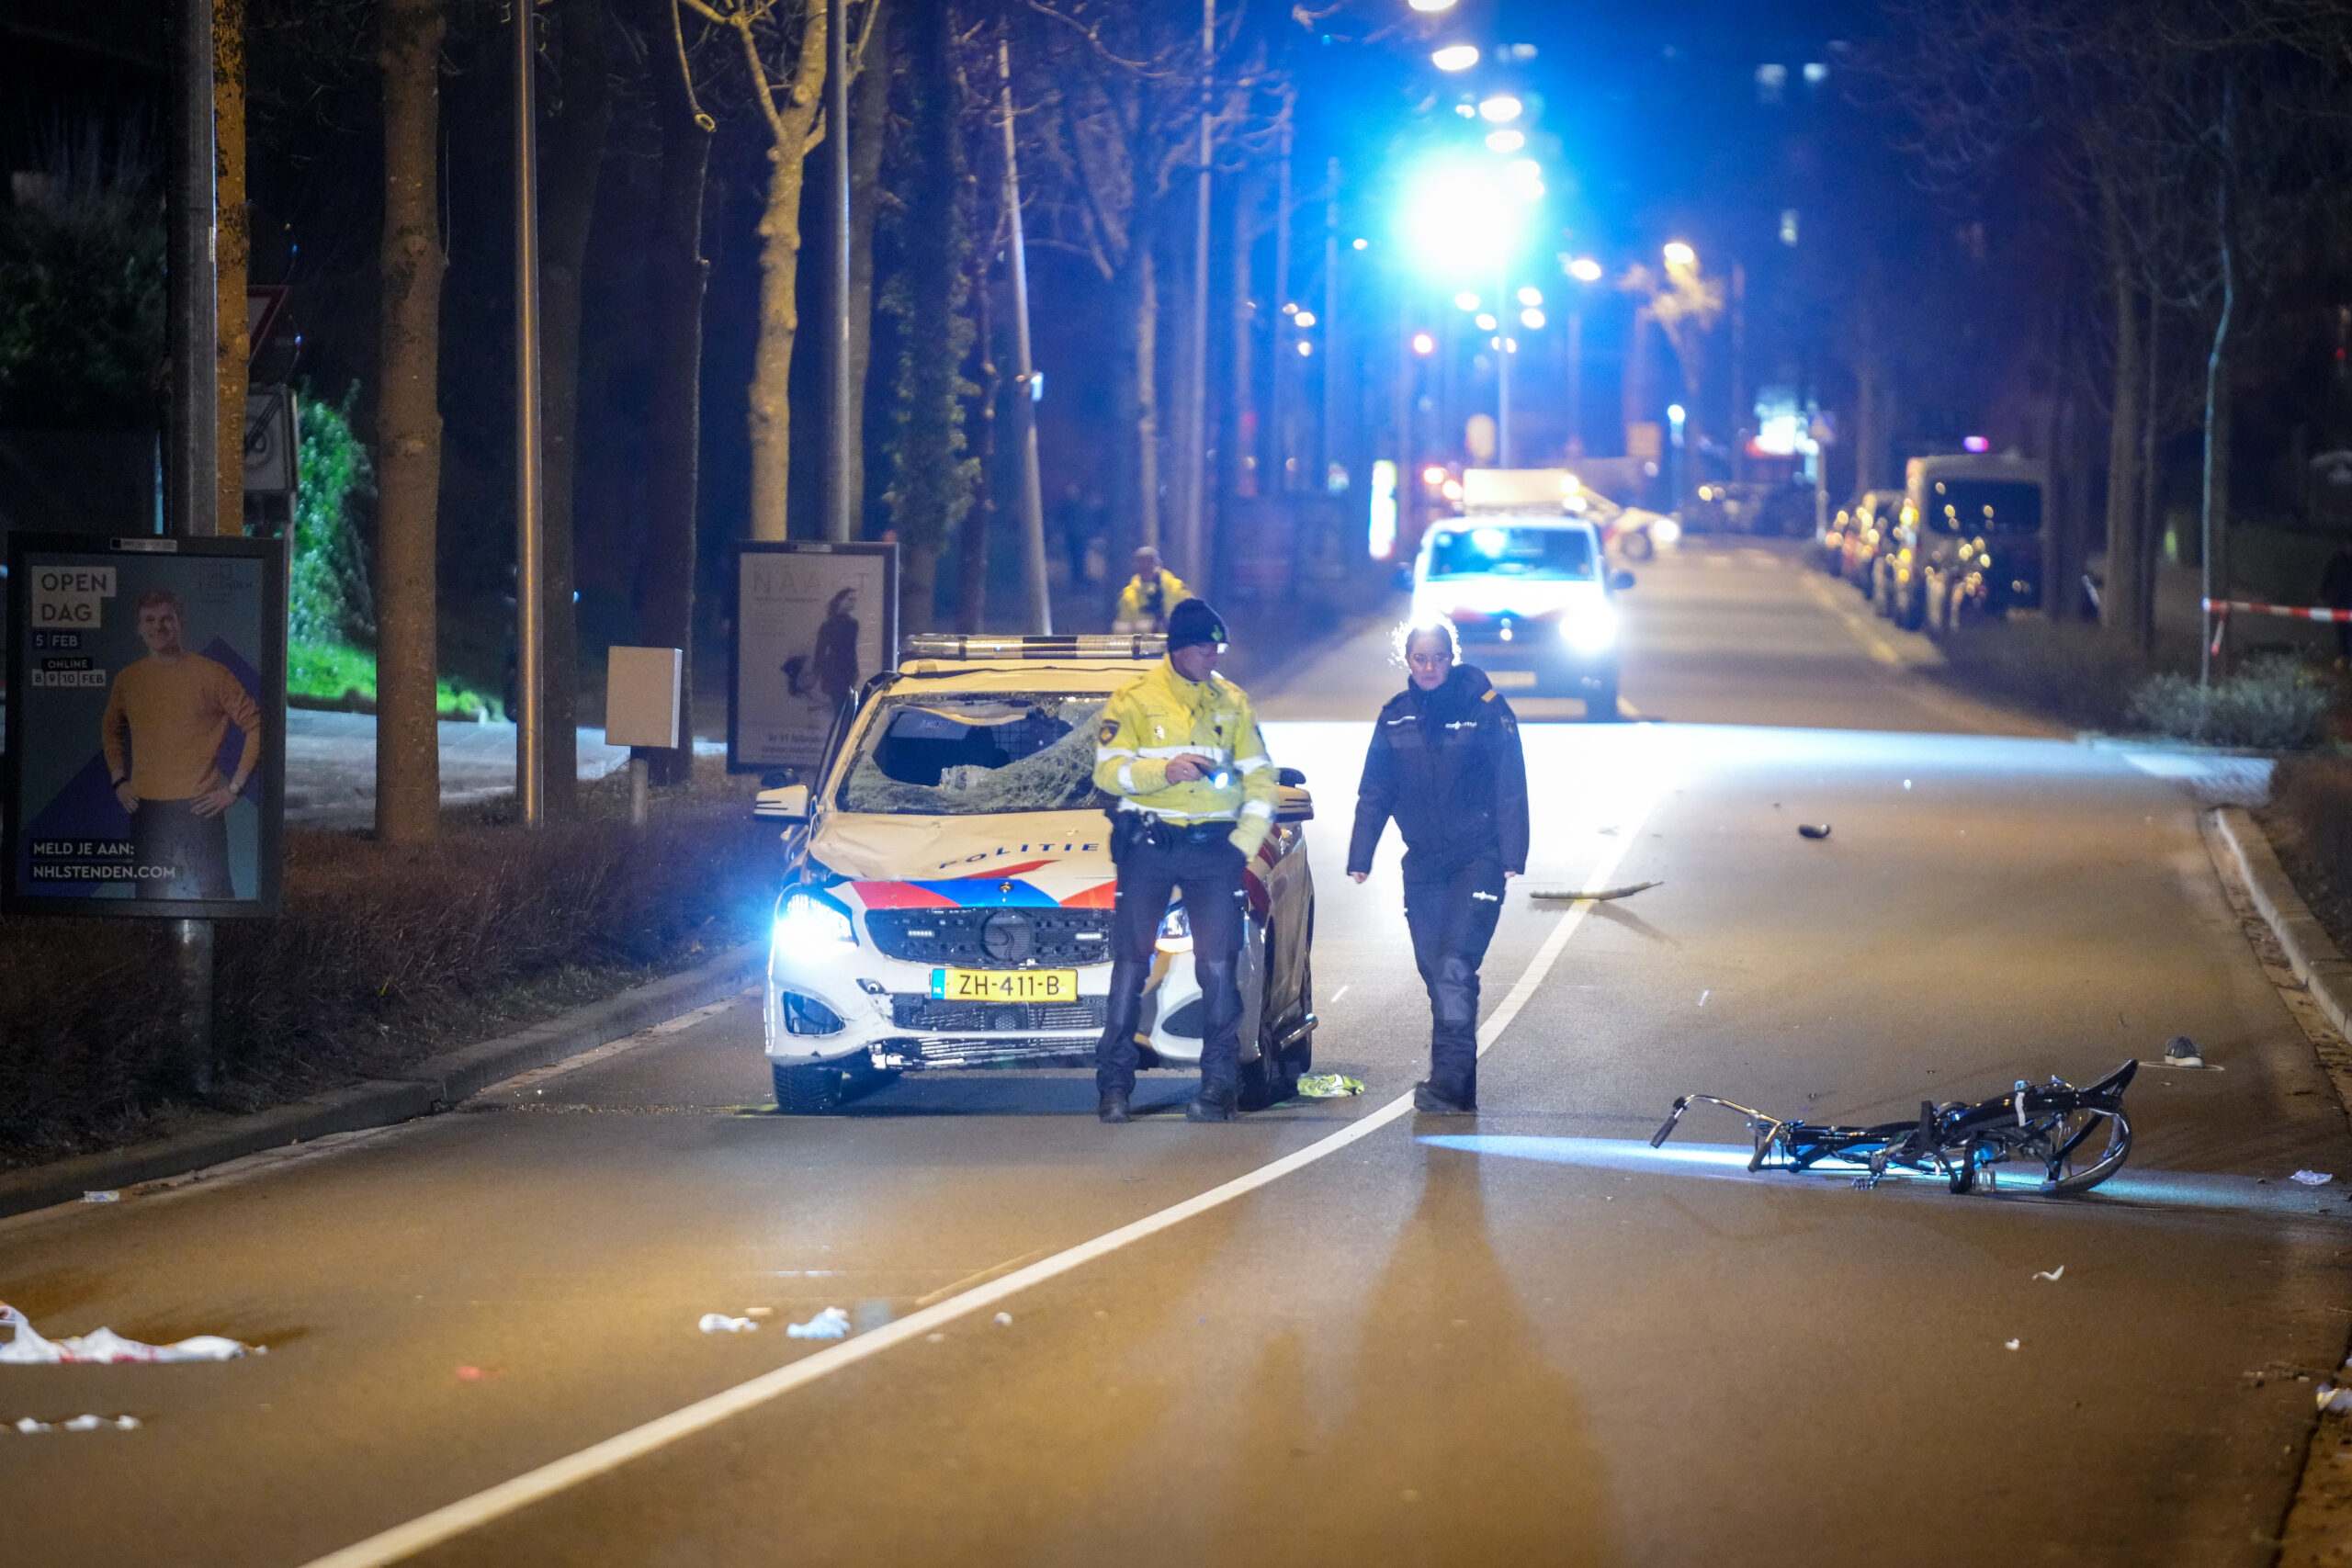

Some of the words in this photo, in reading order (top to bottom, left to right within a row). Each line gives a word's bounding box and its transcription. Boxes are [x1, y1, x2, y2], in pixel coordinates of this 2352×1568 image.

[41, 572, 107, 592] OPEN
[41, 603, 92, 622] DAG
[35, 634, 43, 647] 5
[52, 634, 78, 647] FEB
[48, 660, 88, 669] ONLINE
[35, 673, 42, 683] 8
[49, 673, 55, 683] 9
[63, 673, 75, 683] 10
[83, 673, 104, 683] FEB
[33, 842, 74, 855] MELD
[77, 842, 93, 855] JE
[97, 842, 135, 855] AAN:
[939, 843, 1100, 870] POLITIE
[33, 865, 176, 878] NHLSTENDEN.COM
[959, 974, 1059, 997] ZH-411-B
